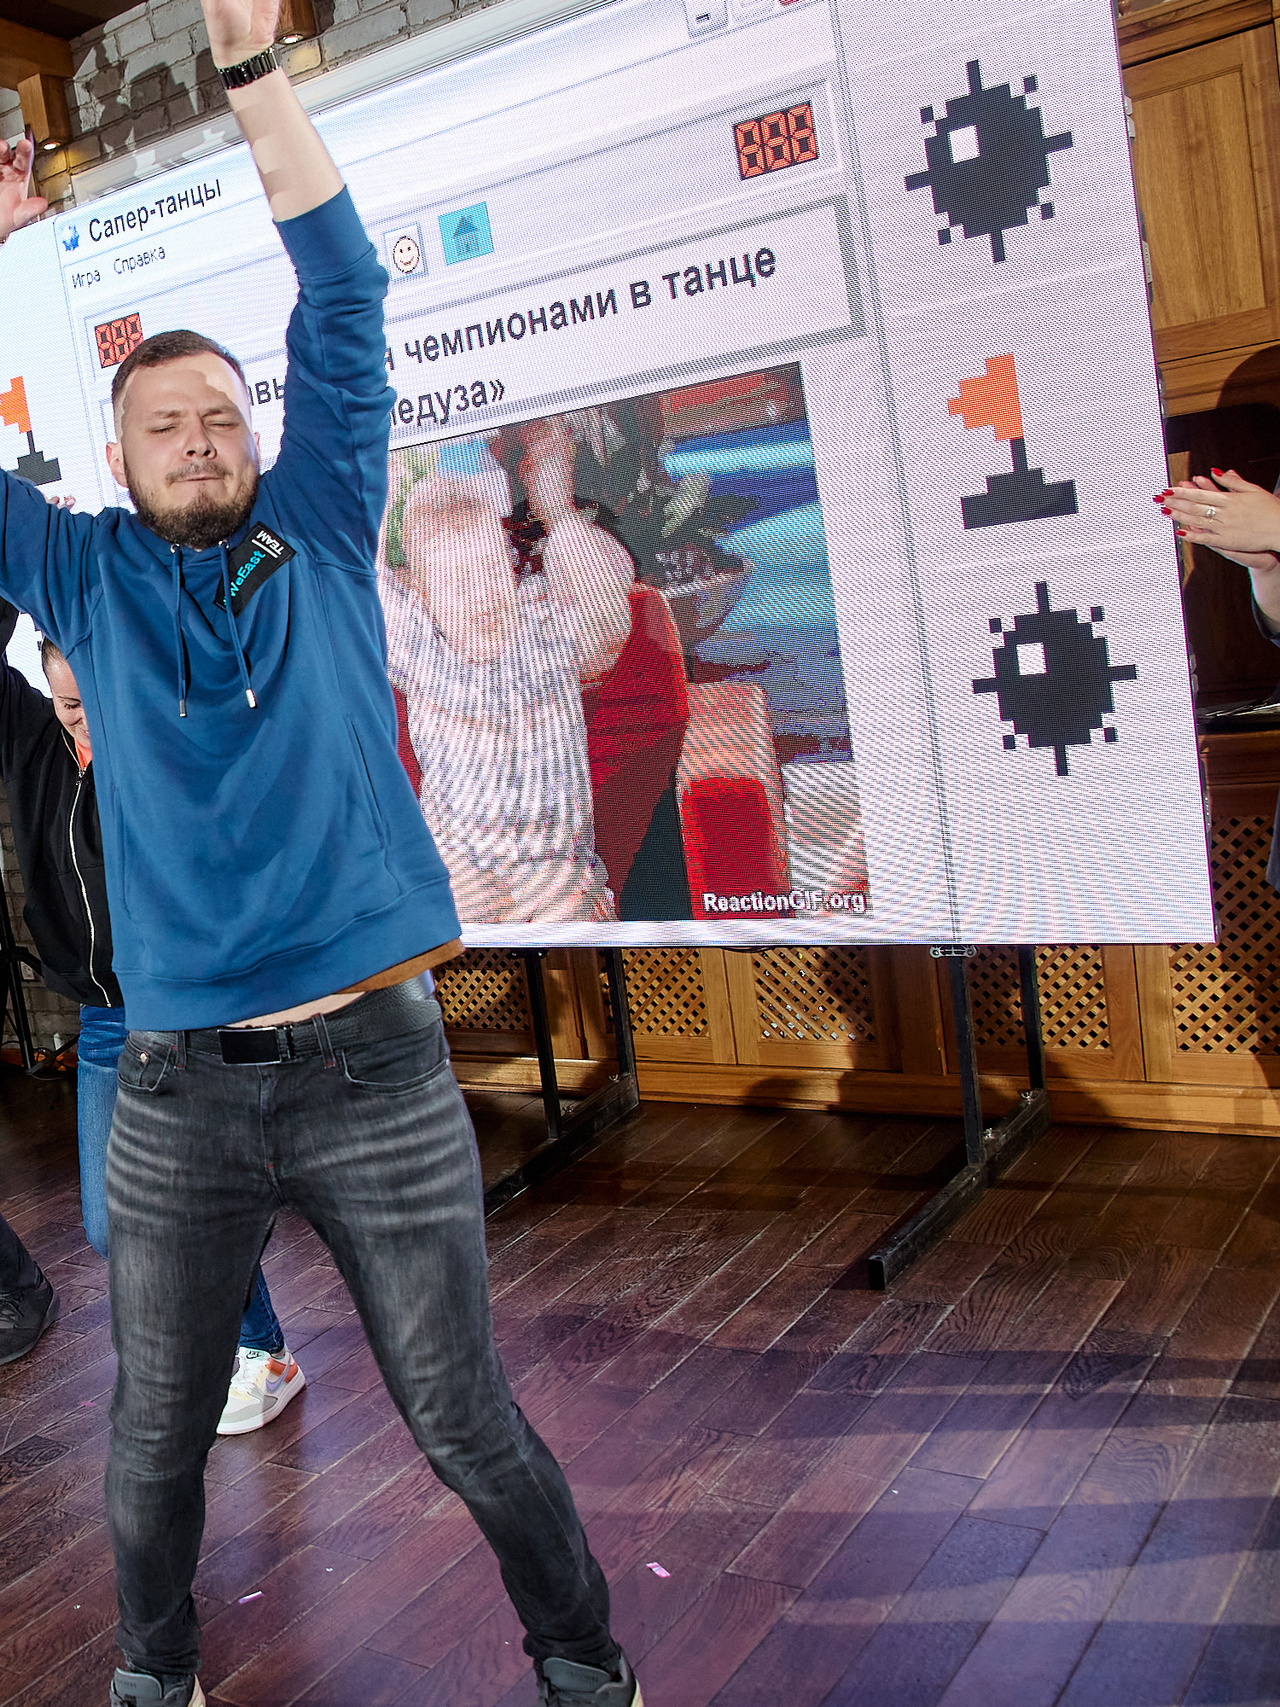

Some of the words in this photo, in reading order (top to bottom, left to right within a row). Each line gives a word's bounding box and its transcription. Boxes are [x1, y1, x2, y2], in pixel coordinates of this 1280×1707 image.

[89, 179, 221, 242] Сапер-танцы
[72, 269, 101, 289] Игра
[113, 246, 166, 275] Справка
[404, 289, 618, 364] чемпионами
[629, 280, 653, 309] в
[661, 247, 776, 300] танце
[256, 530, 285, 556] TEAM
[702, 888, 868, 914] ReactionGIF.org
